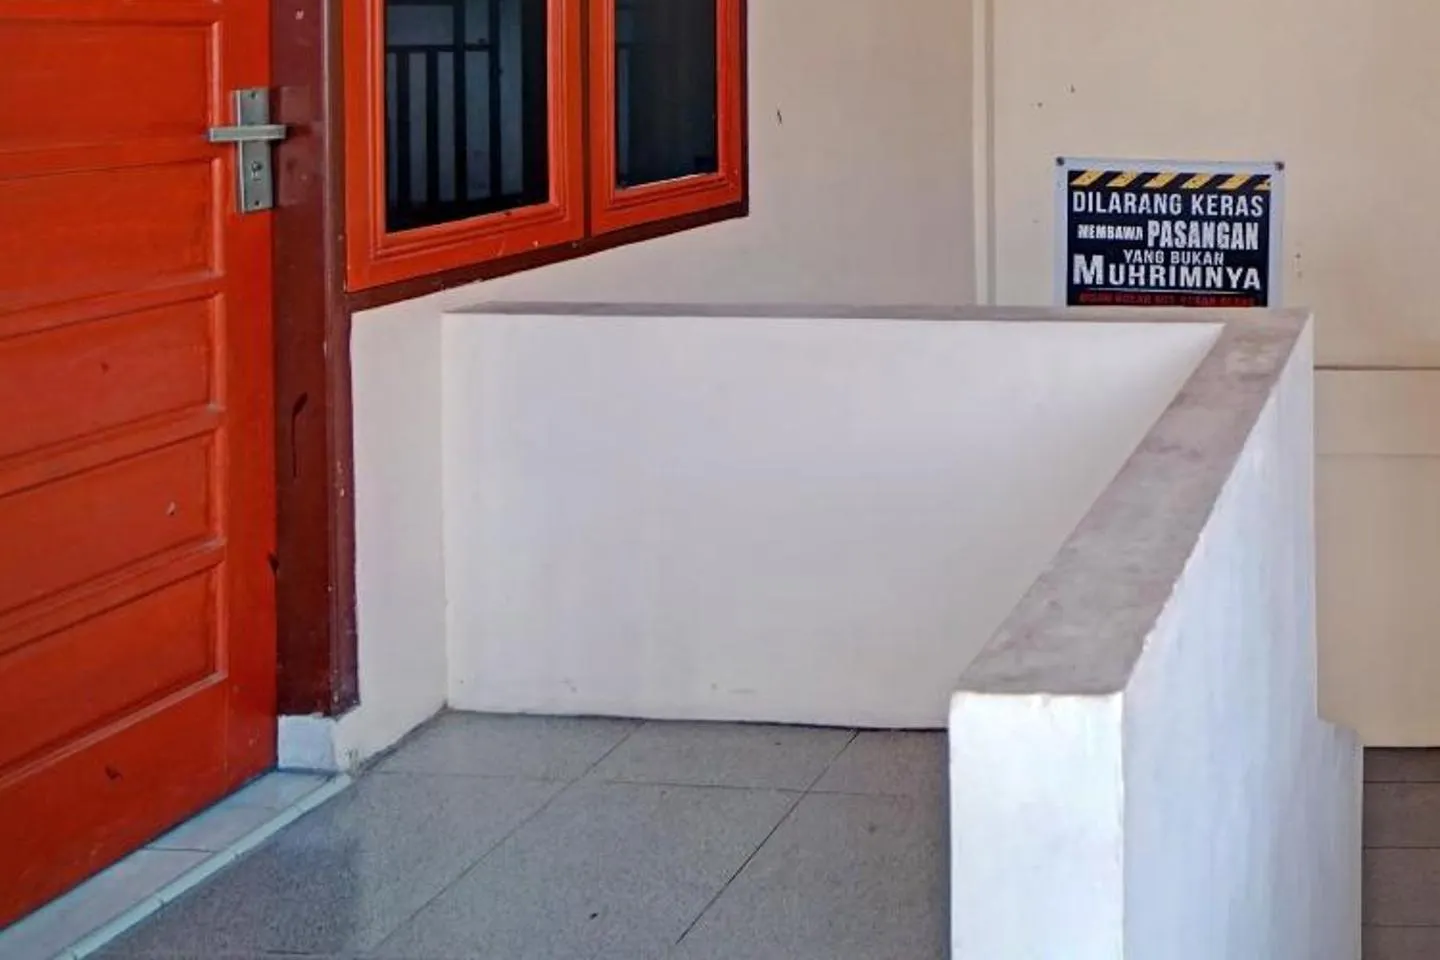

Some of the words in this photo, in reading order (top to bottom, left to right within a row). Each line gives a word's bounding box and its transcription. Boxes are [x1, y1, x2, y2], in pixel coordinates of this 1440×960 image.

[1073, 191, 1182, 215] DILARANG
[1191, 194, 1263, 217] KERAS
[1077, 224, 1144, 240] MEMBAWA
[1147, 220, 1259, 250] PASANGAN
[1123, 249, 1164, 264] YANG
[1170, 251, 1225, 265] BUKAN
[1072, 254, 1261, 289] MUHRIMNYA
